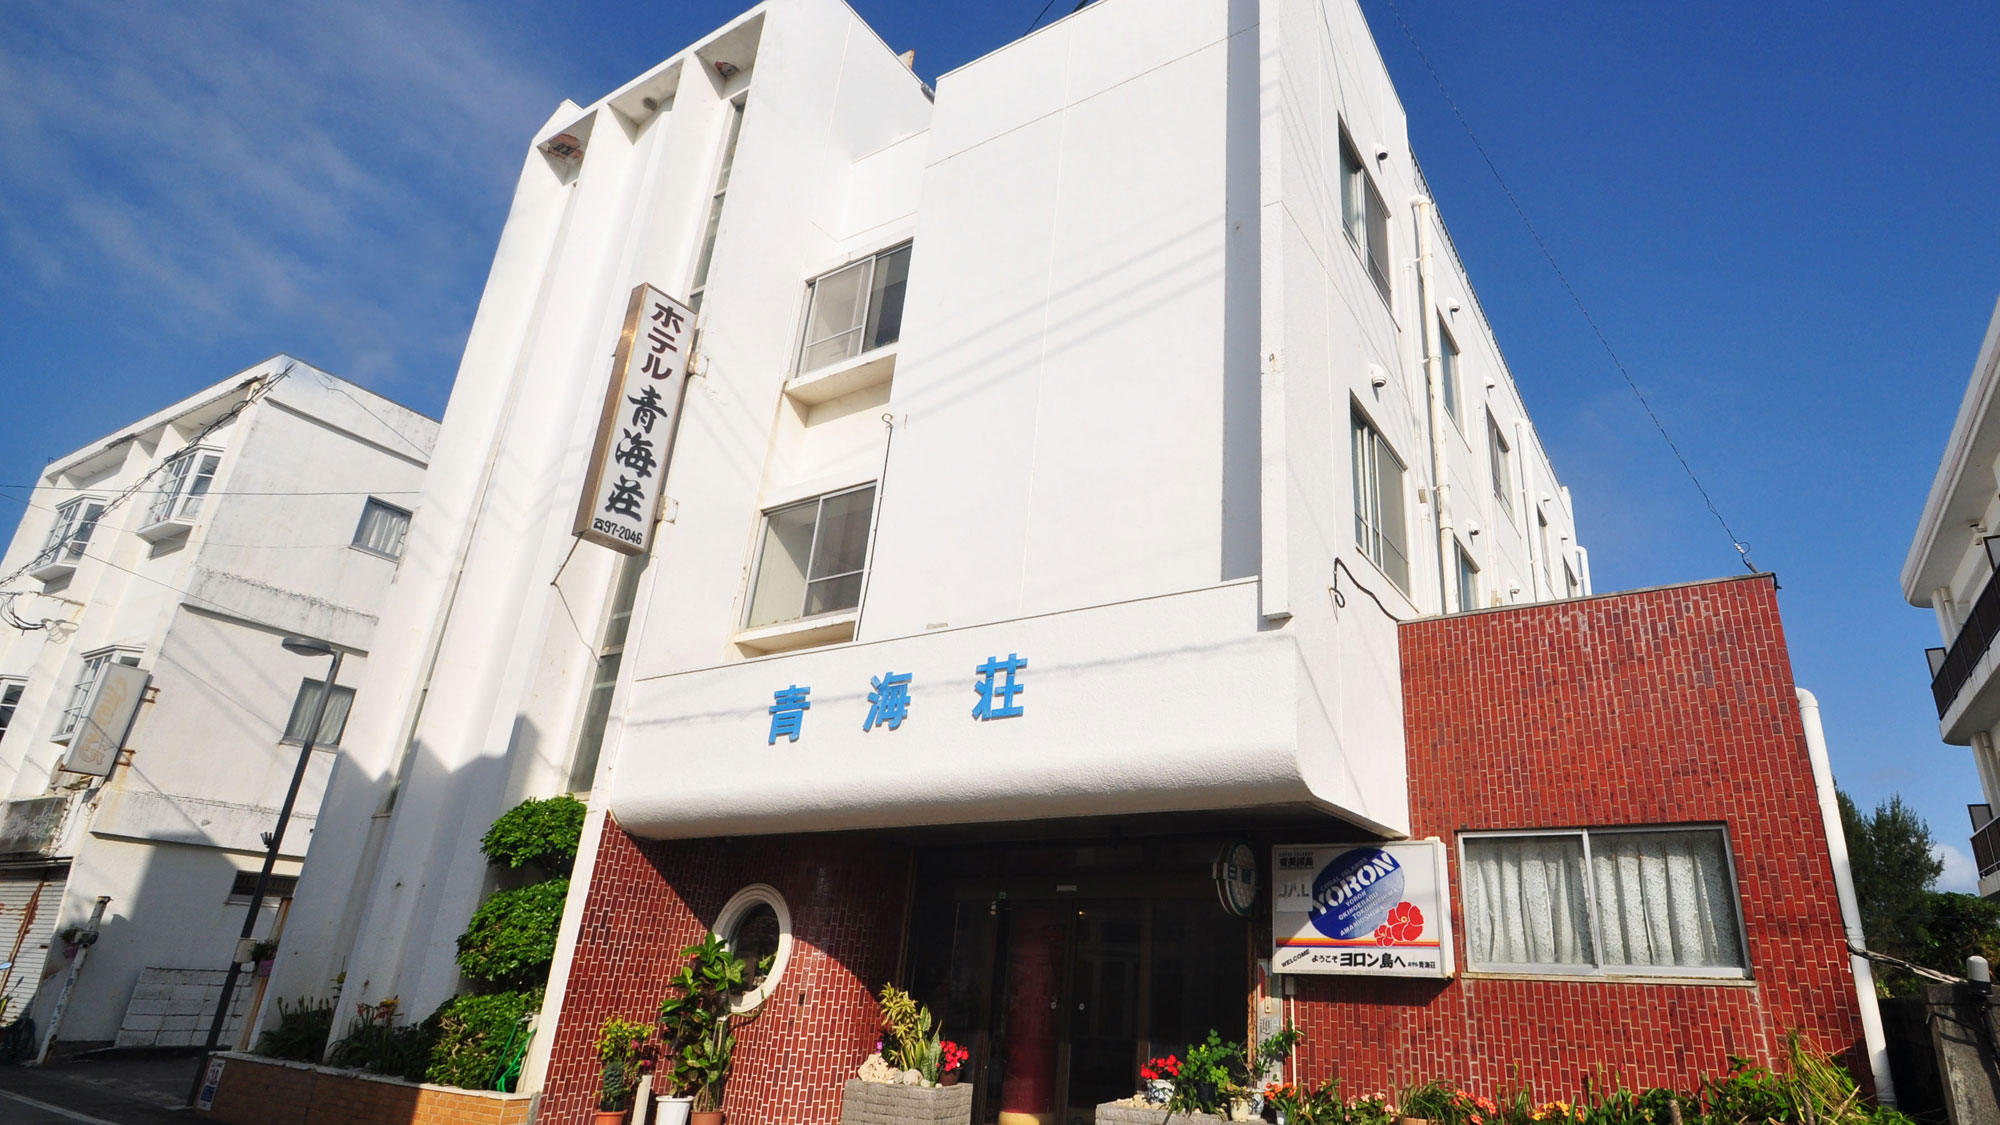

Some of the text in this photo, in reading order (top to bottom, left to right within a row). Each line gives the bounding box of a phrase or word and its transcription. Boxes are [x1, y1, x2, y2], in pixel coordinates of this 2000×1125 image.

[768, 653, 1028, 746] 青海荘
[1279, 883, 1310, 897] JAL
[1312, 852, 1395, 915] YORON
[1338, 892, 1379, 921] OKINOERABU
[1345, 890, 1367, 907] YORON
[1281, 949, 1310, 968] WELCOME
[1311, 954, 1338, 964] ようこそ
[1339, 952, 1406, 969] ヨロン島へ
